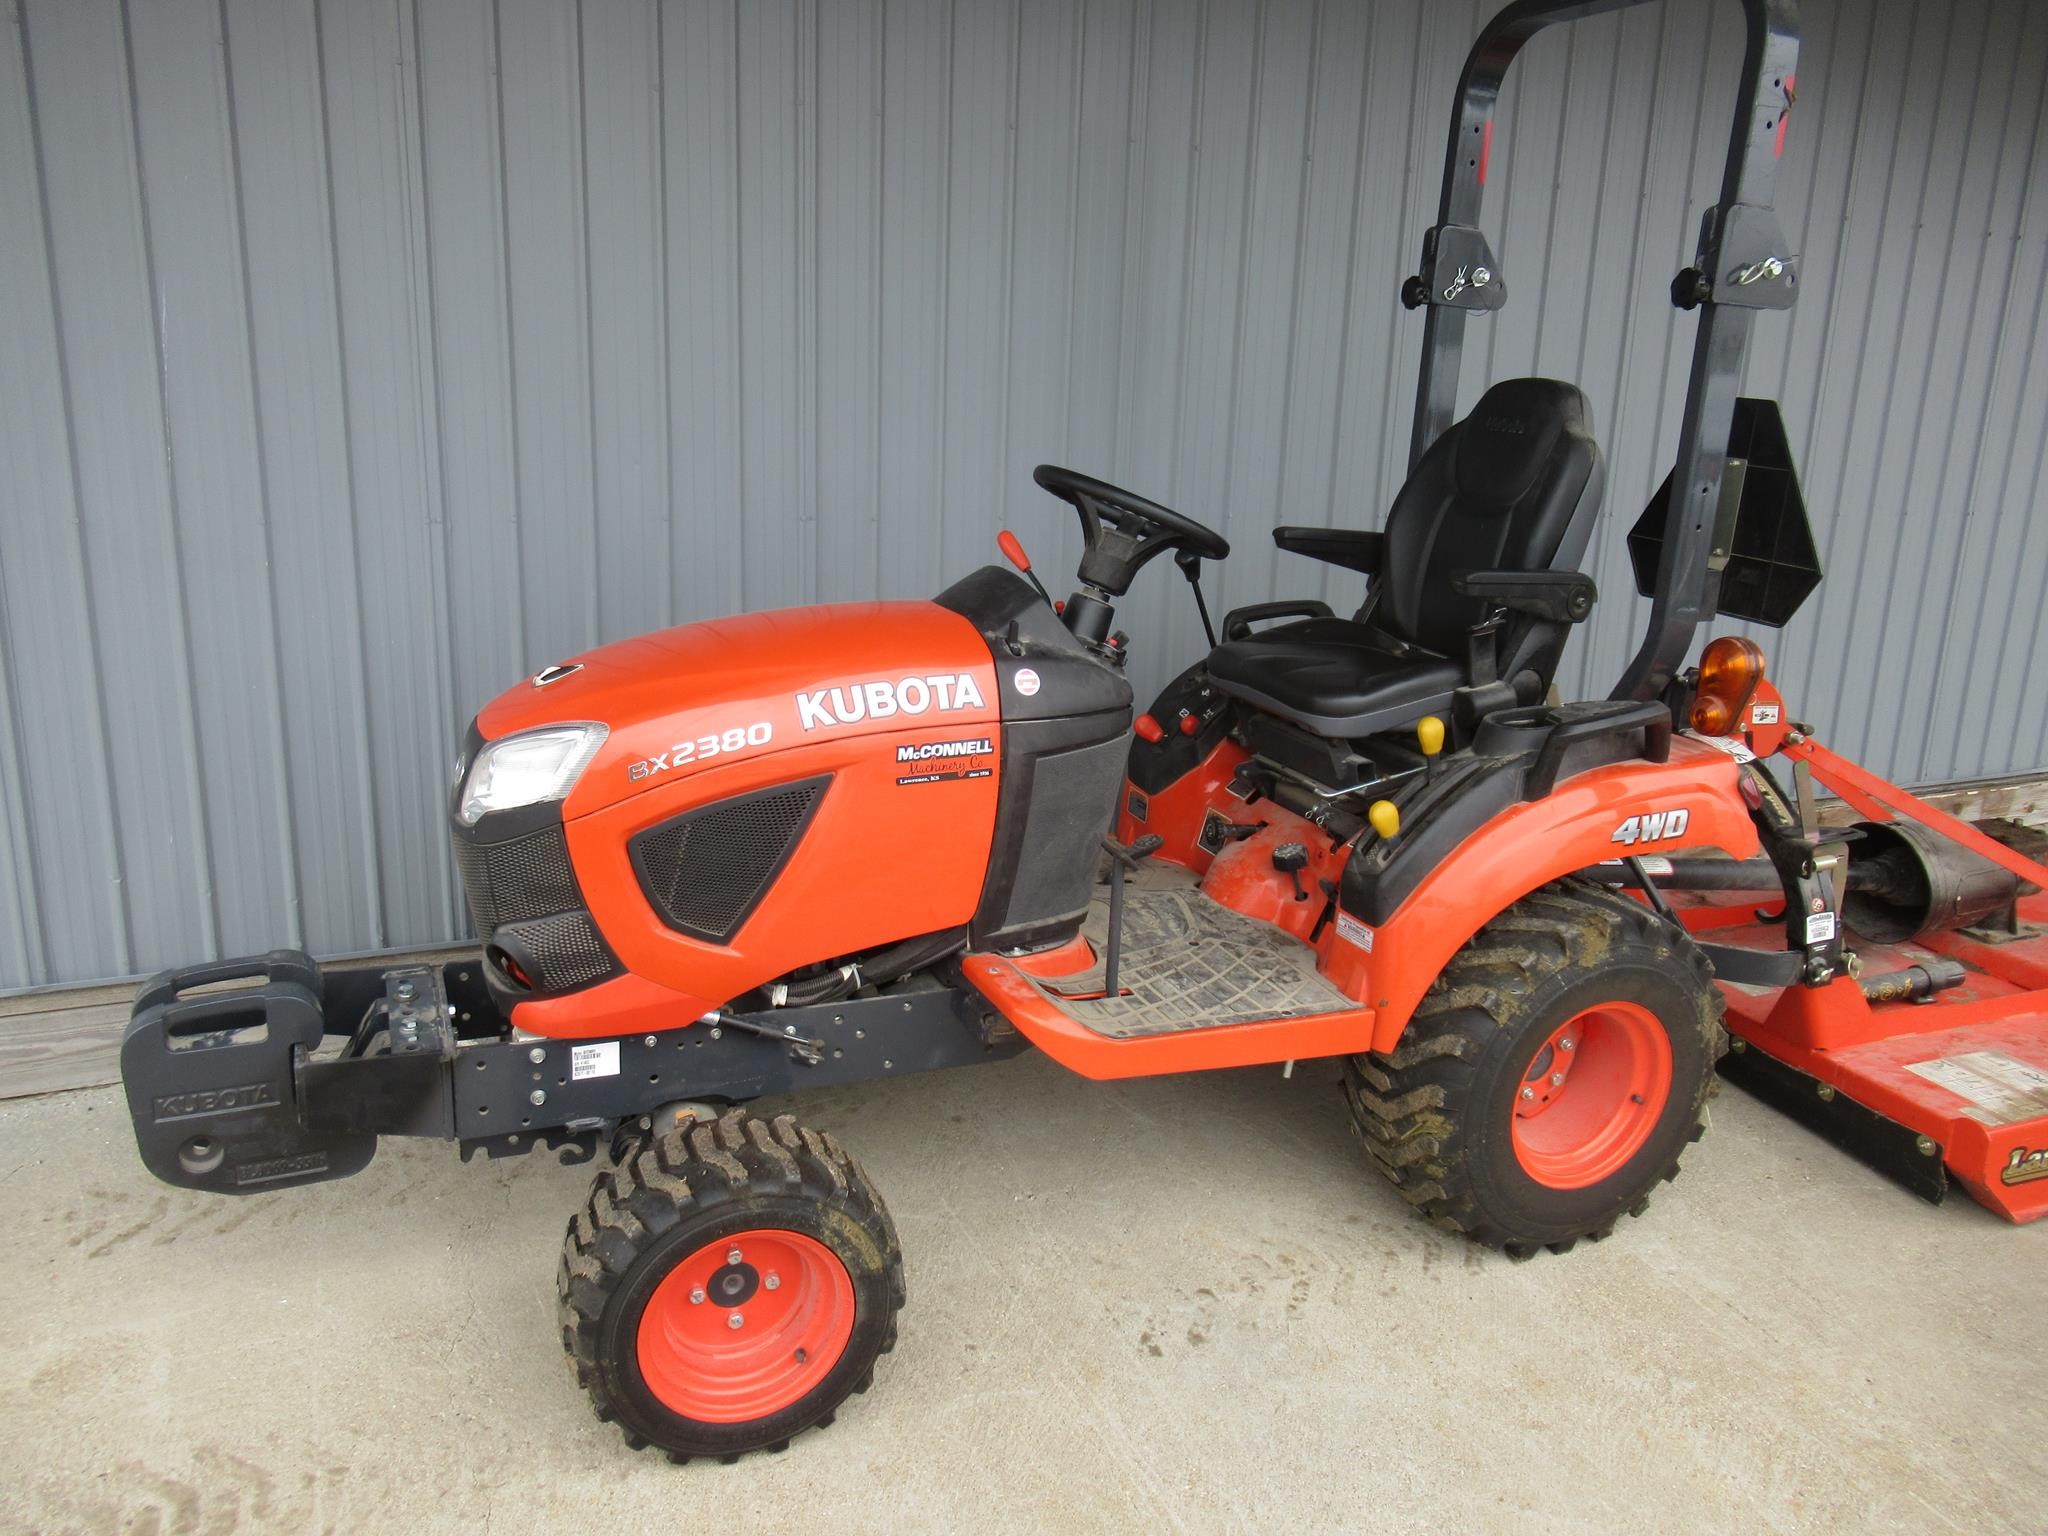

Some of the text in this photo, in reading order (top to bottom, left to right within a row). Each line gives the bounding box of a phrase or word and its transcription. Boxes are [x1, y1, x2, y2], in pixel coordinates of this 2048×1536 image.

[796, 673, 985, 730] KUBOTA
[628, 722, 773, 782] BX2380
[897, 740, 993, 761] McCONNELL
[908, 756, 966, 777] Machinery
[1611, 808, 1689, 846] 4WD
[156, 1083, 267, 1114] KUBOTA
